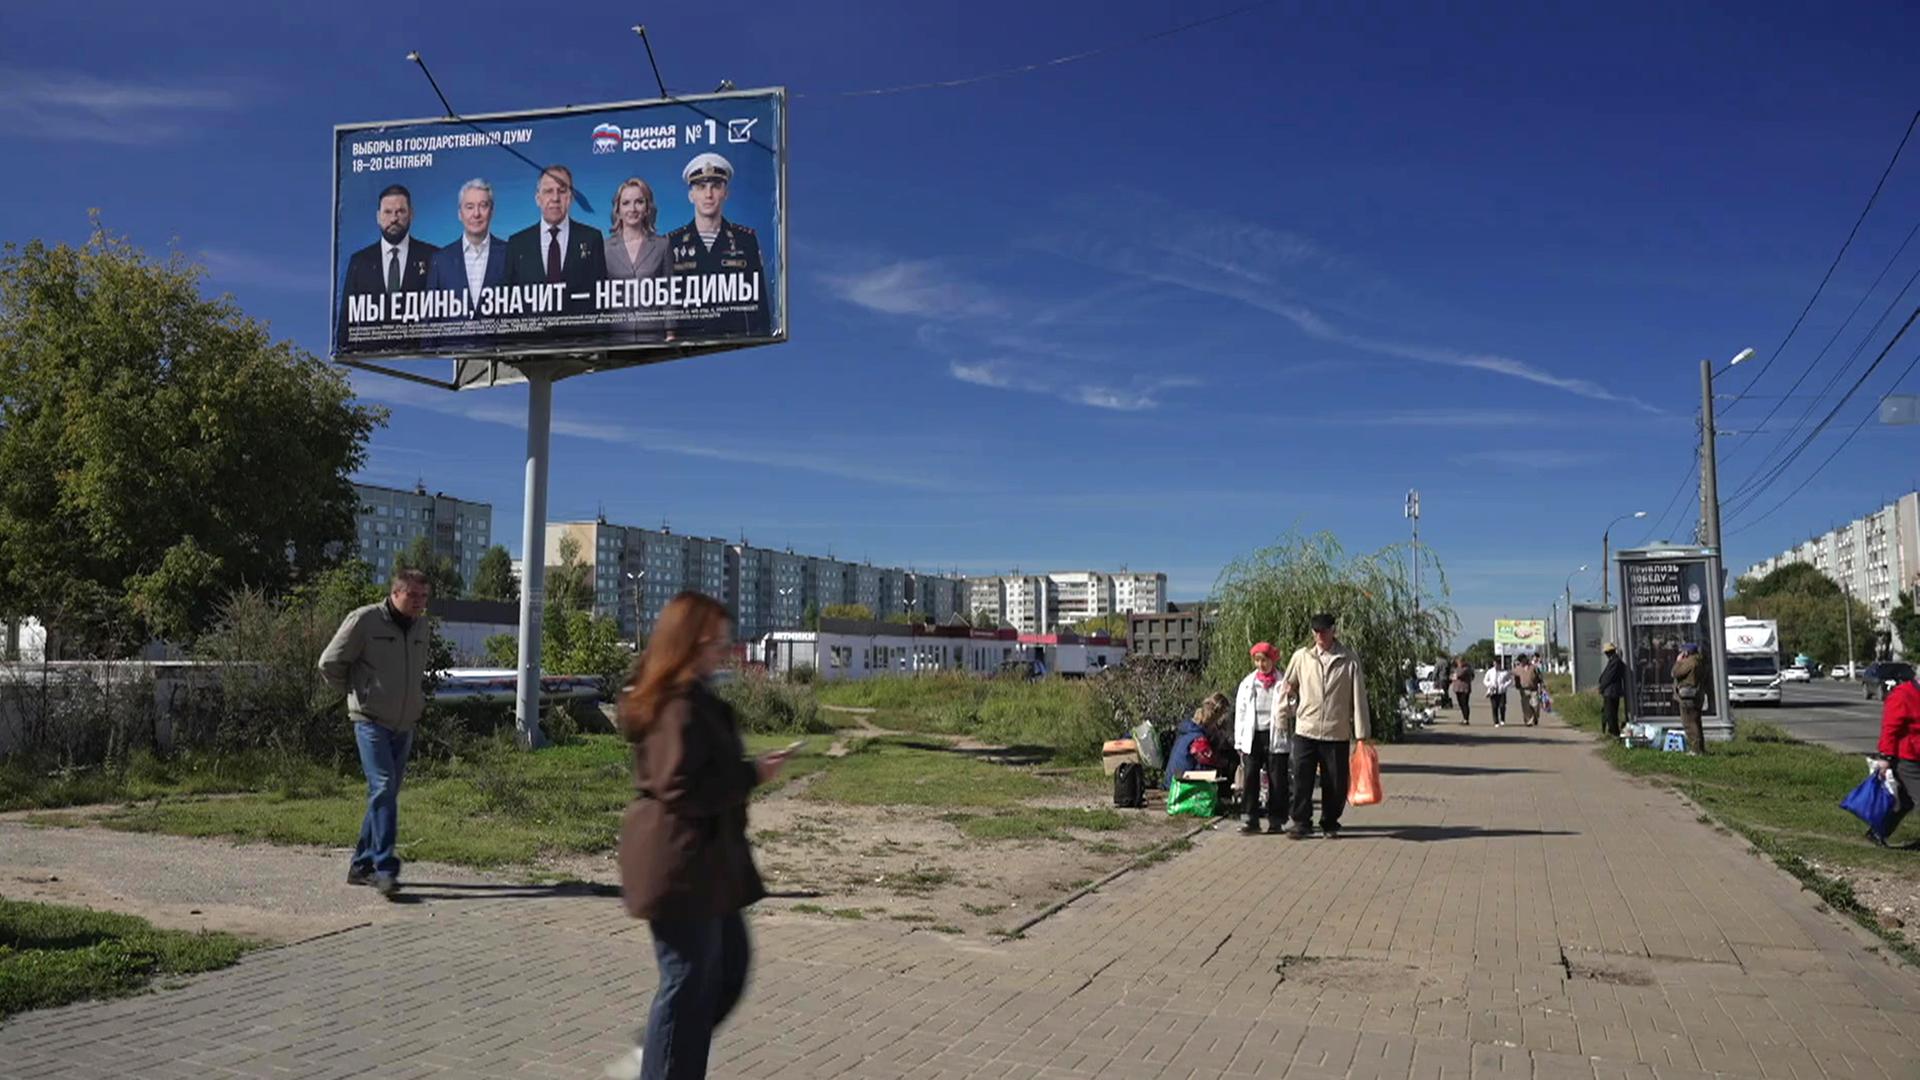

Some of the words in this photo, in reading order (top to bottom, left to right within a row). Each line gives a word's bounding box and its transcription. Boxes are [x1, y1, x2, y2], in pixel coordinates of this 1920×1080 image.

[623, 125, 676, 140] ЕДИНАЯ
[352, 141, 394, 156] ВЫБОРЫ
[396, 140, 403, 151] В
[404, 131, 501, 152] ГОСУДАРСТВЕННУЮ
[502, 129, 533, 145] ДУМУ
[623, 137, 676, 152] РОССИЯ
[384, 153, 433, 170] СЕНТЯБРЯ
[348, 293, 385, 323] МЫ
[391, 288, 475, 322] ЕДИНЫ,
[481, 282, 567, 316] ЗНАЧИТ
[595, 271, 760, 309] НЕПОБЕДИМЫ
[1630, 573, 1667, 583] ПОБЕДУ
[1631, 585, 1679, 594] ПОДПИШИ
